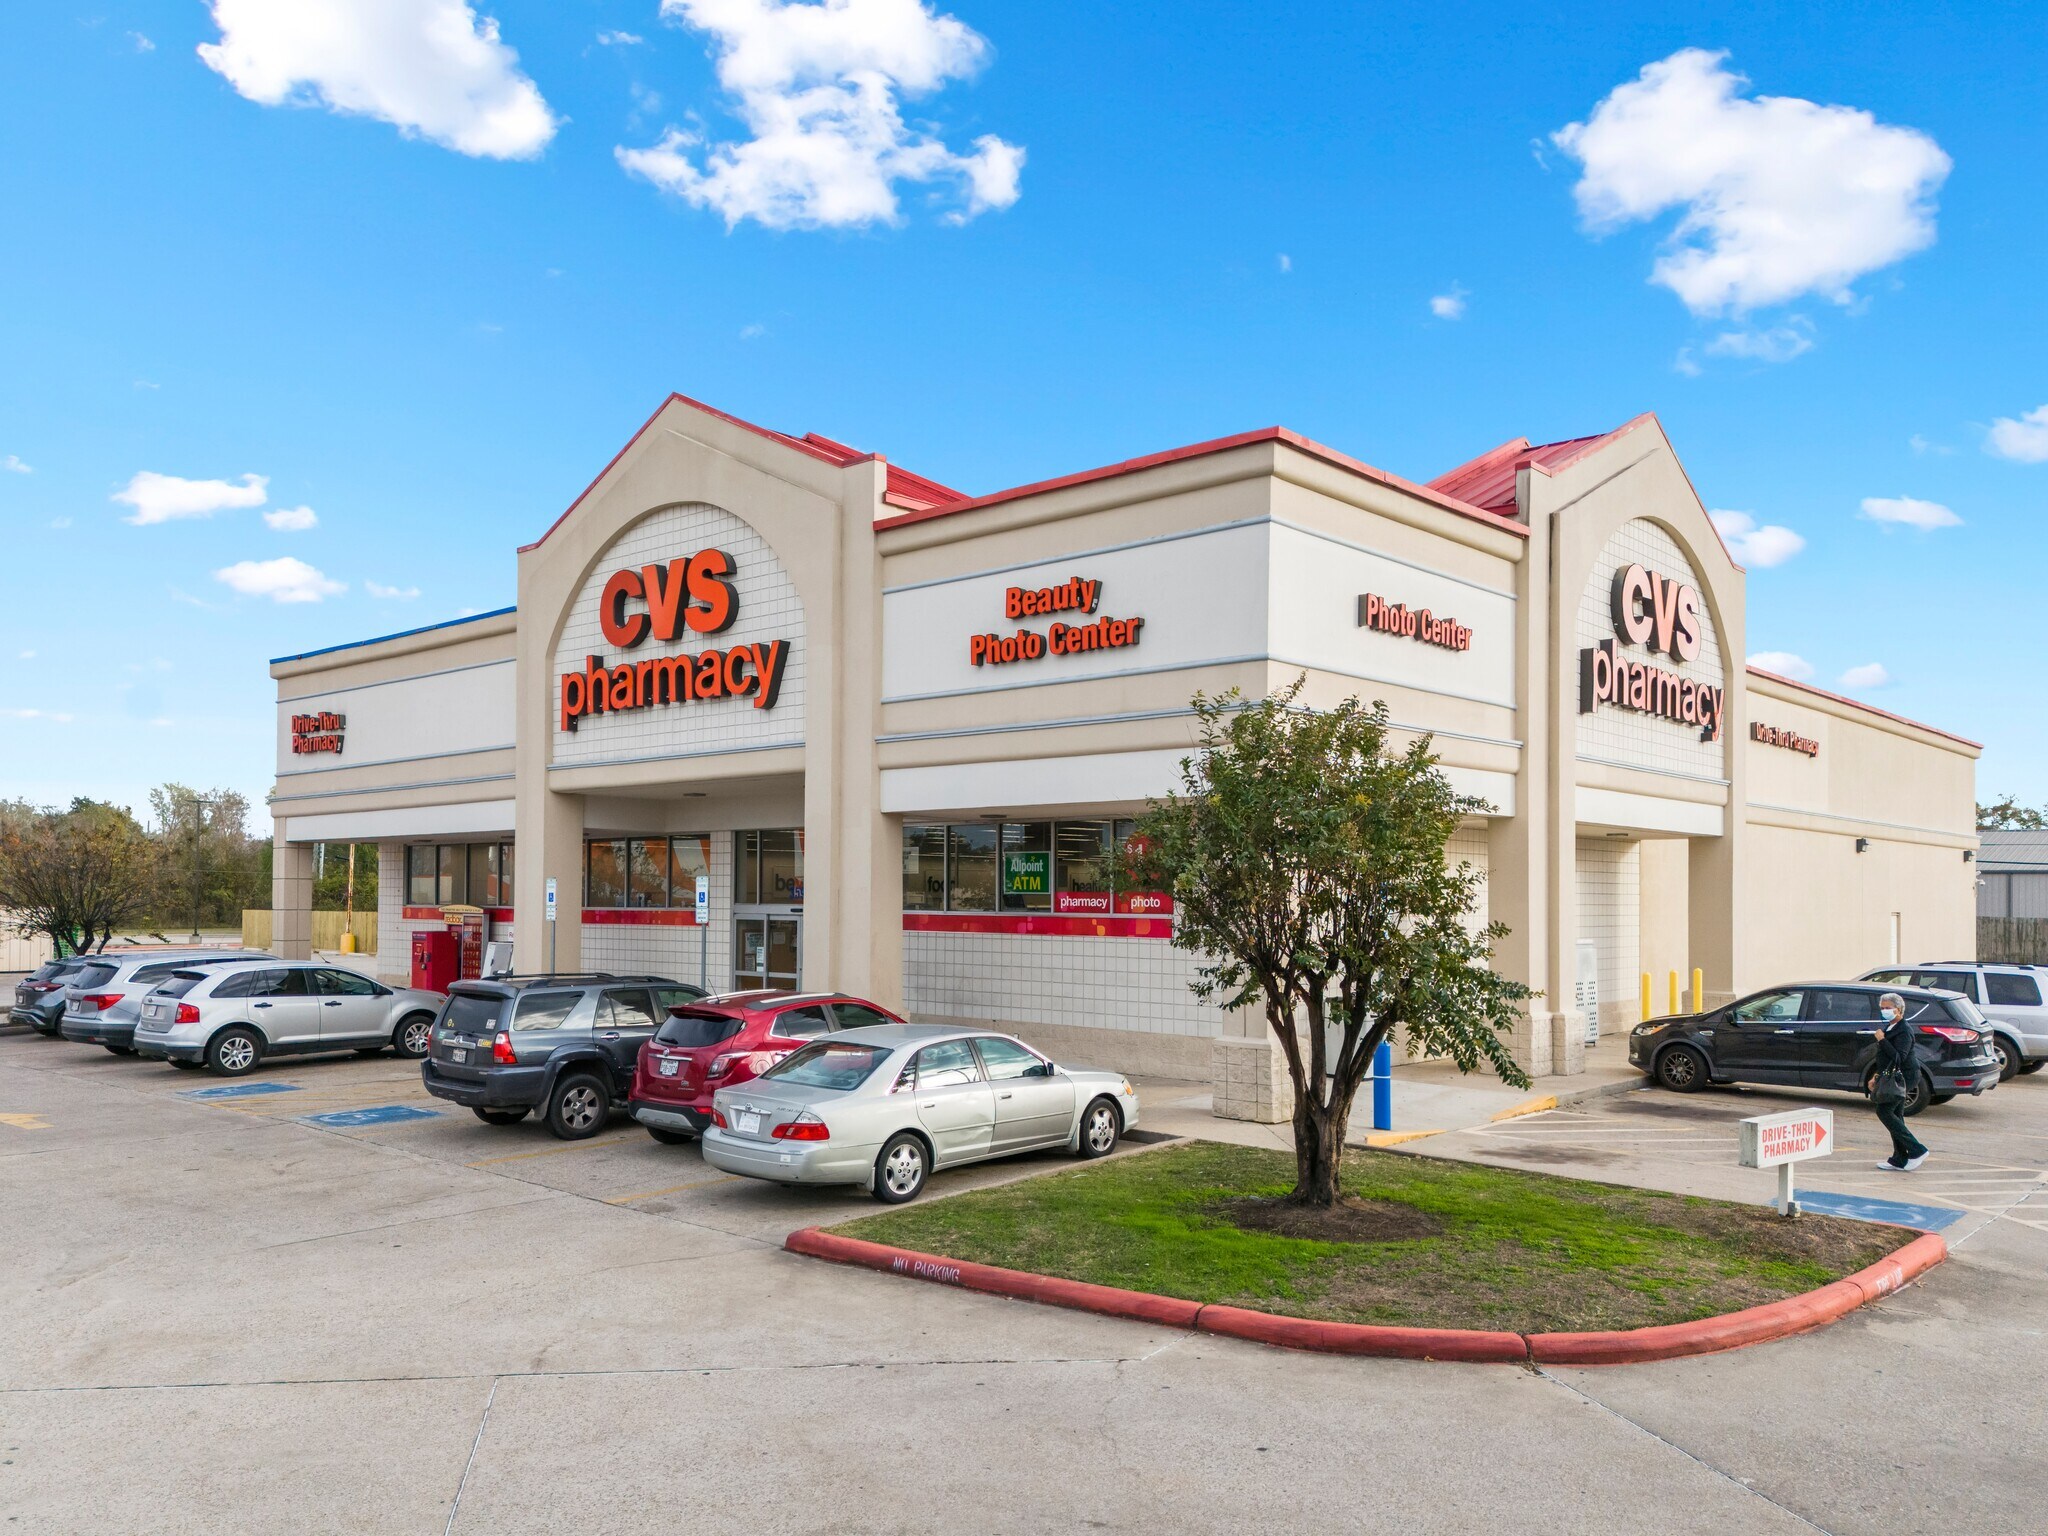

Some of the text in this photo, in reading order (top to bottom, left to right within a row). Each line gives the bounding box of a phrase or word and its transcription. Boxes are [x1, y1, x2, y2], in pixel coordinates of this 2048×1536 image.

[600, 548, 737, 648] CVS
[1006, 576, 1101, 618] Beauty
[1360, 593, 1472, 651] Photo Center
[1613, 562, 1701, 663] CVS
[971, 616, 1143, 666] Photo Center
[561, 639, 787, 732] pharmacy
[1584, 638, 1724, 743] pharmacy
[292, 712, 343, 733] Drive-Thru
[292, 735, 342, 754] Pharmacy
[1752, 722, 1819, 757] Drive-Thru Pharmacy
[1010, 857, 1044, 875] Allpoint
[1013, 876, 1041, 890] ATM
[1060, 896, 1108, 909] pharmacy
[1130, 896, 1160, 909] photo
[1762, 1121, 1813, 1143] DRIVE-THRU
[1764, 1137, 1811, 1158] PHARMACY
[914, 1260, 960, 1282] PARKING
